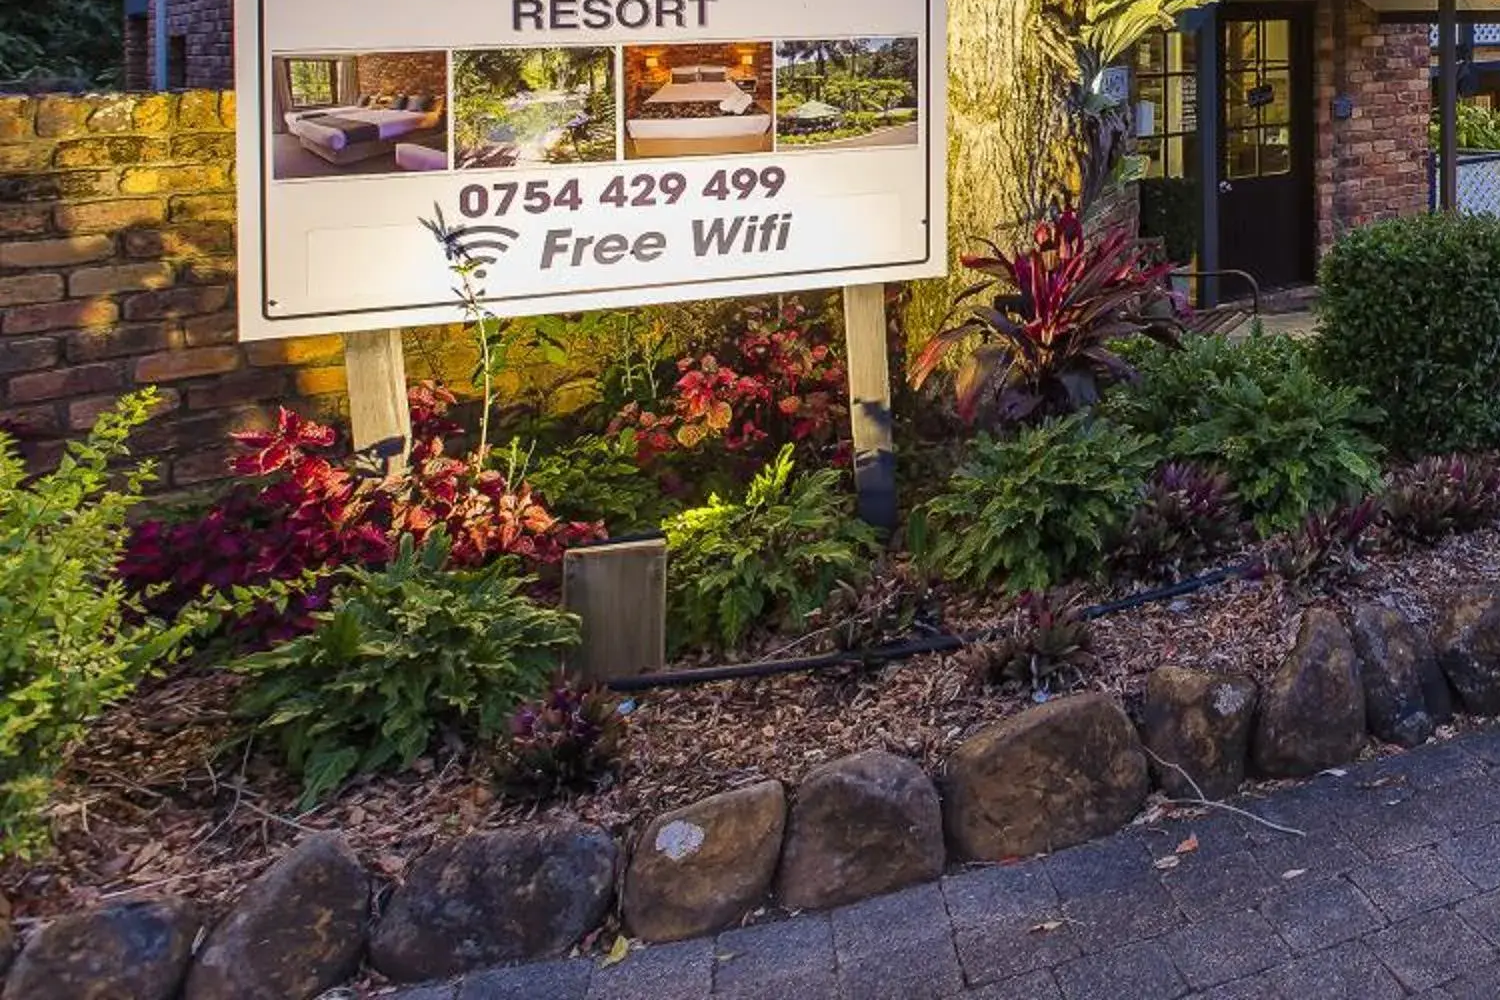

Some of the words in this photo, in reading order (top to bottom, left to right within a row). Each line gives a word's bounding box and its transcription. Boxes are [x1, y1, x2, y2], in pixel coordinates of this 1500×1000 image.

[459, 179, 583, 219] 0754
[598, 170, 688, 209] 429
[702, 165, 786, 202] 499
[539, 227, 667, 270] Free
[691, 212, 793, 258] Wifi
